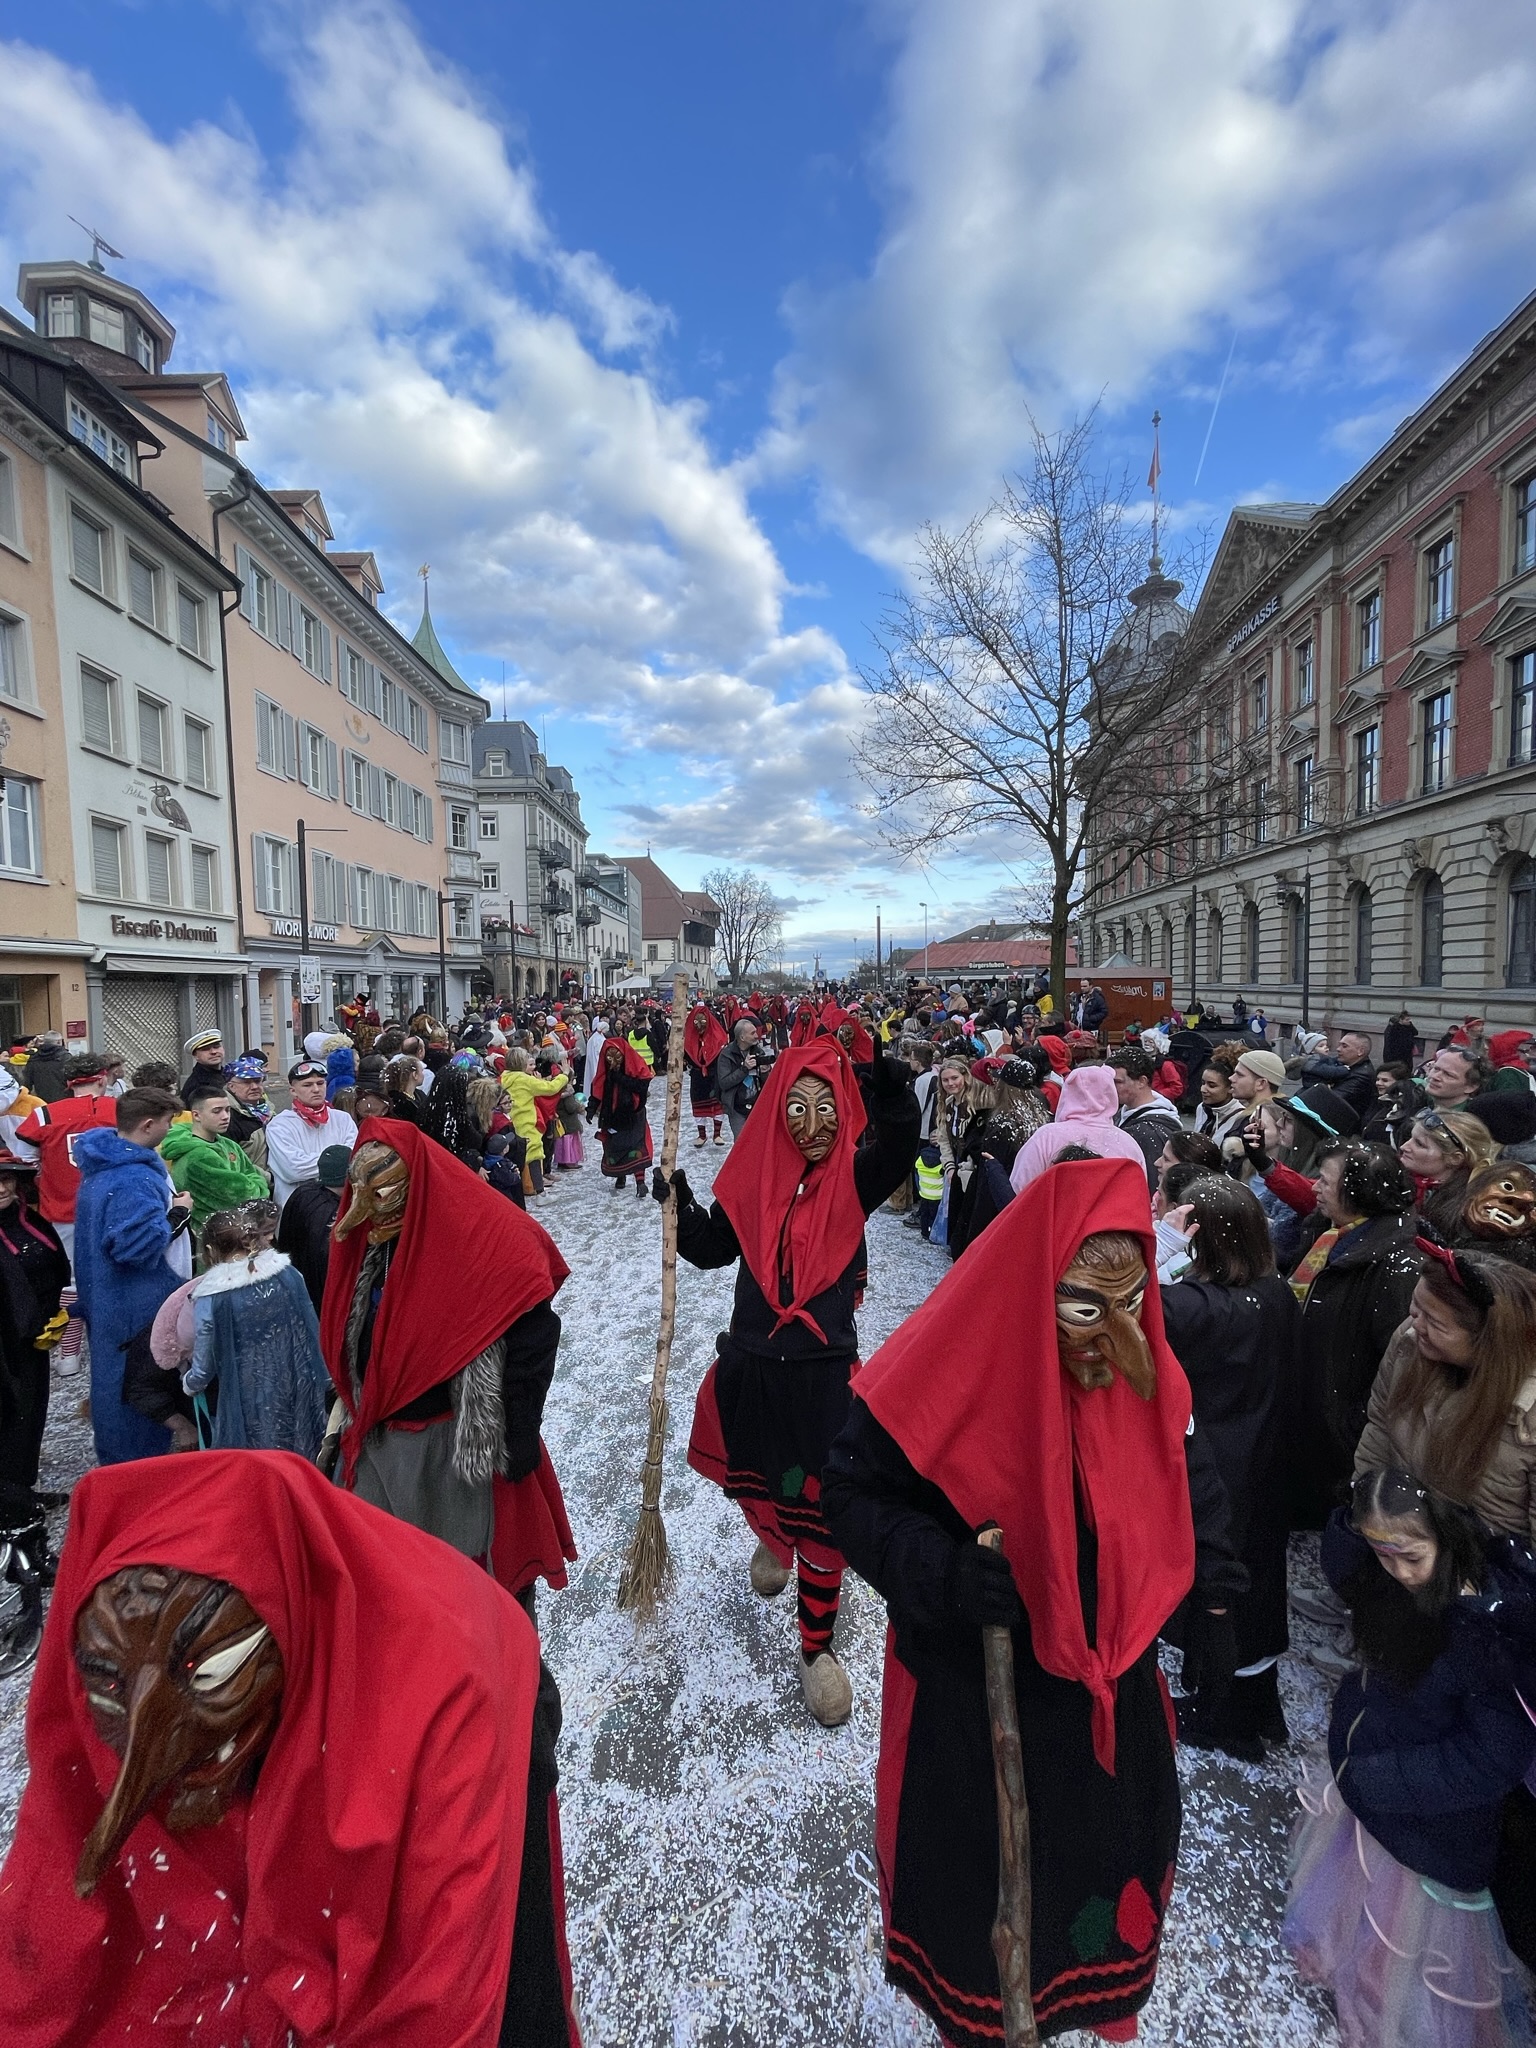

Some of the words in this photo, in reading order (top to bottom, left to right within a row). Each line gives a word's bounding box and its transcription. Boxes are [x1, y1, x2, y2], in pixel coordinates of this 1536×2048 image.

[1226, 595, 1279, 654] SPARKASSE
[164, 920, 218, 943] Dolomiti
[313, 925, 339, 941] MORE
[71, 983, 80, 992] 12
